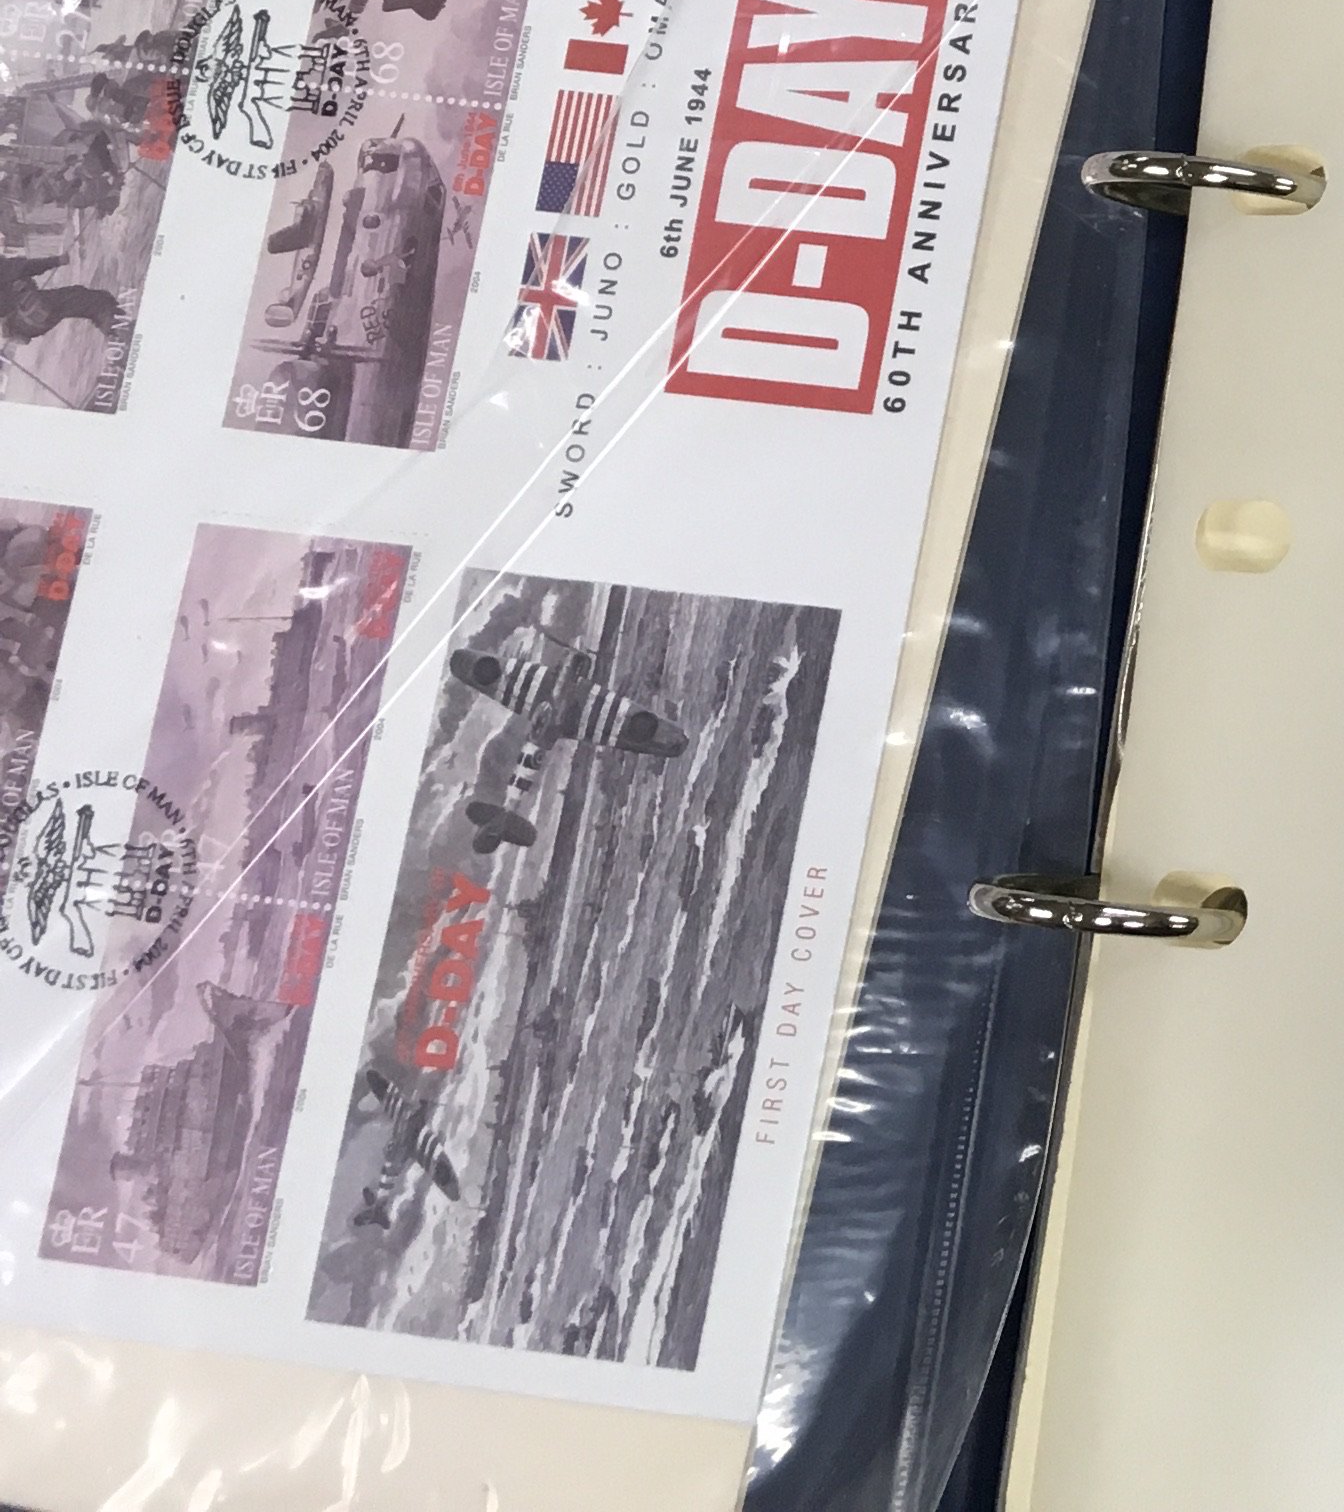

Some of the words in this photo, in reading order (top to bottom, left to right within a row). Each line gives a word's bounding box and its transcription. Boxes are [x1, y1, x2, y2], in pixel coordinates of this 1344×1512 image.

[370, 41, 404, 84] 68
[493, 27, 514, 52] OF
[484, 55, 509, 97] ISLE
[689, 67, 713, 134] 1944
[201, 150, 242, 176] DAY
[311, 129, 345, 161] 2004
[464, 112, 498, 196] D-DAY
[665, 136, 699, 209] JUNE
[660, 219, 681, 259] 6th
[113, 288, 137, 331] MAN
[555, 392, 596, 519] SWORD
[597, 252, 624, 342] JUNO
[617, 109, 650, 203] GOLD
[108, 335, 127, 362] OF
[432, 323, 453, 370] MAN
[883, 308, 924, 413] 60TH
[94, 366, 121, 407] ISLE
[426, 370, 444, 398] OF
[294, 386, 331, 433] 68
[412, 403, 437, 445] ISLE
[327, 769, 354, 817] MAN
[322, 823, 343, 849] OF
[19, 956, 62, 986] DAY
[75, 770, 119, 788] ISLE
[147, 786, 185, 826] MAN
[146, 844, 174, 924] D-DAY
[311, 852, 337, 897] ISLE
[415, 871, 491, 1071] D-DAY
[756, 1058, 789, 1145] FIRST
[776, 982, 805, 1037] DAY
[791, 866, 828, 961] COVER
[251, 1145, 277, 1196] MAN
[113, 1212, 150, 1264] 47
[244, 1202, 267, 1228] OF
[234, 1237, 261, 1279] ISLE
